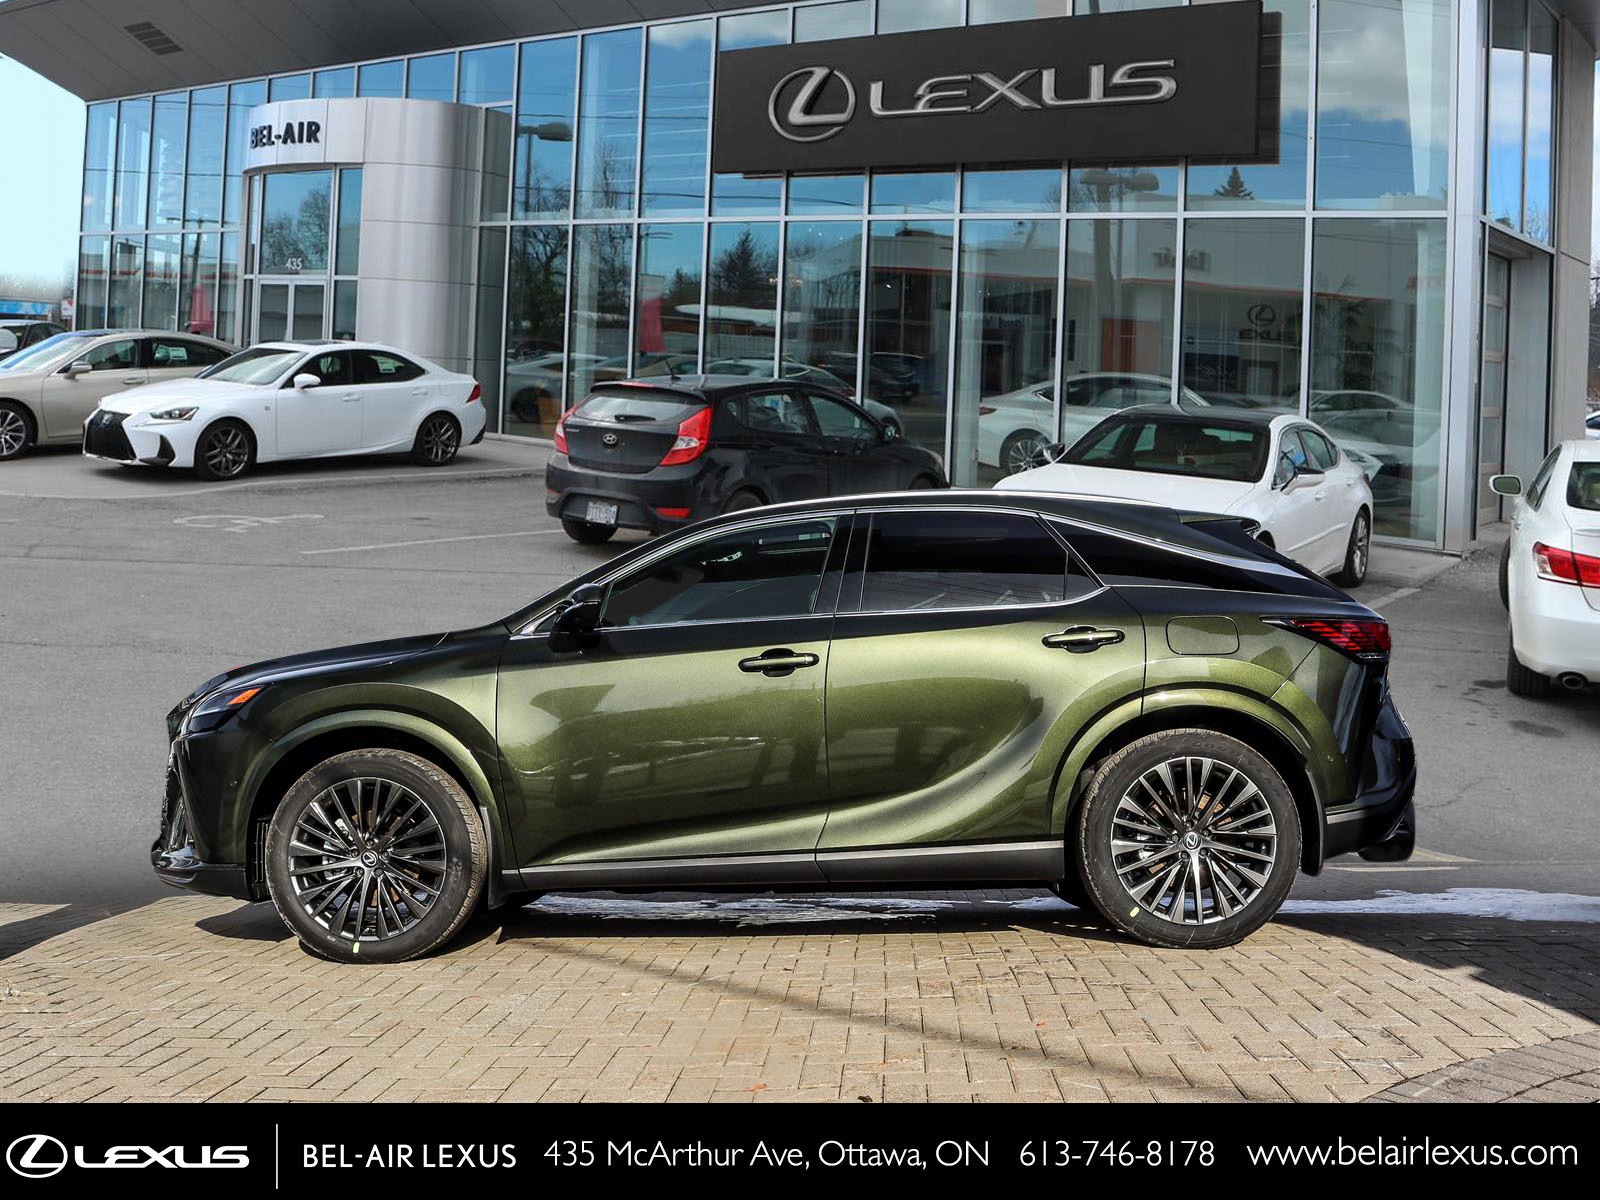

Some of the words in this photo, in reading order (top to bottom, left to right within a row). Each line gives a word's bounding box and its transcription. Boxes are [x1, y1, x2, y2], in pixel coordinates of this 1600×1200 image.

[870, 59, 1177, 117] LEXUS
[250, 121, 321, 149] BEL-AIR
[285, 257, 303, 271] 435
